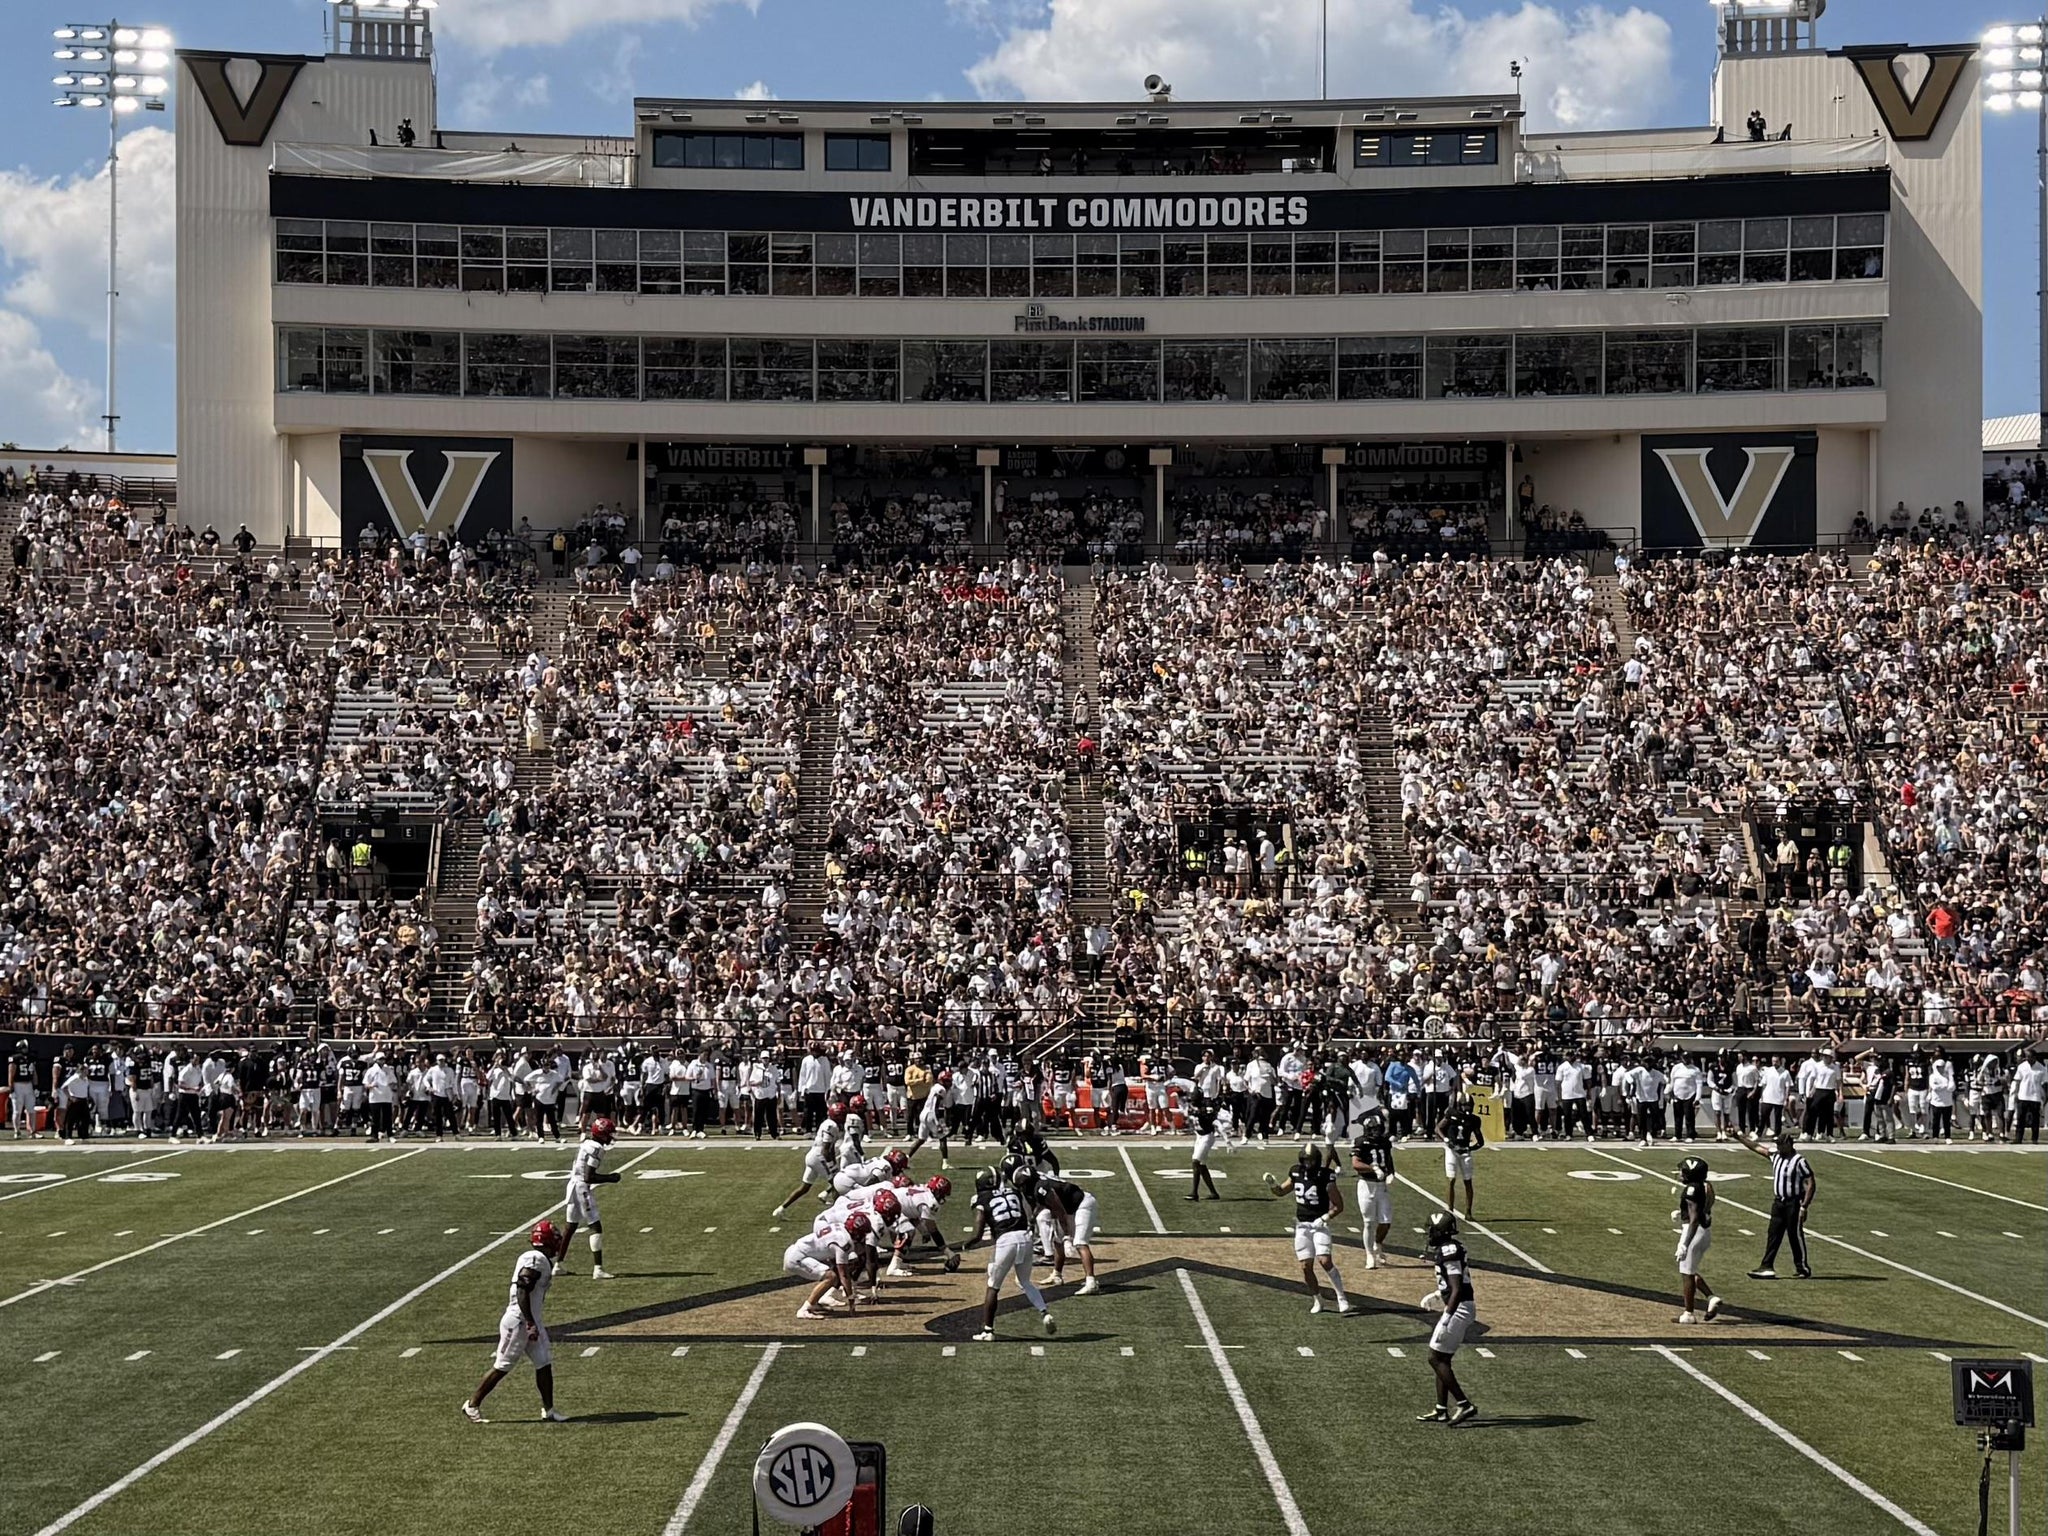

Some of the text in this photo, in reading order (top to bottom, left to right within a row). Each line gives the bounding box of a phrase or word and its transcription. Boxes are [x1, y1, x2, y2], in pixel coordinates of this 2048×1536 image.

[179, 55, 307, 146] V
[1847, 50, 1977, 141] V
[850, 196, 1308, 227] VANDERBILT COMMODORES
[1014, 315, 1145, 332] FirstBank STADIUM
[667, 448, 794, 468] VANDERBILT
[362, 448, 501, 550] V
[1652, 446, 1795, 547] V
[345, 828, 351, 837] E
[406, 828, 412, 837] E
[1198, 829, 1205, 838] D
[88, 1064, 105, 1076] 73
[345, 1069, 361, 1080] 57
[1476, 1072, 1493, 1085] 35
[1477, 1104, 1491, 1116] 11
[1685, 1159, 1698, 1170] V
[1293, 1182, 1319, 1205] 24
[989, 1193, 1022, 1222] 29
[1430, 1213, 1443, 1225] V
[771, 1446, 832, 1506] SEC
